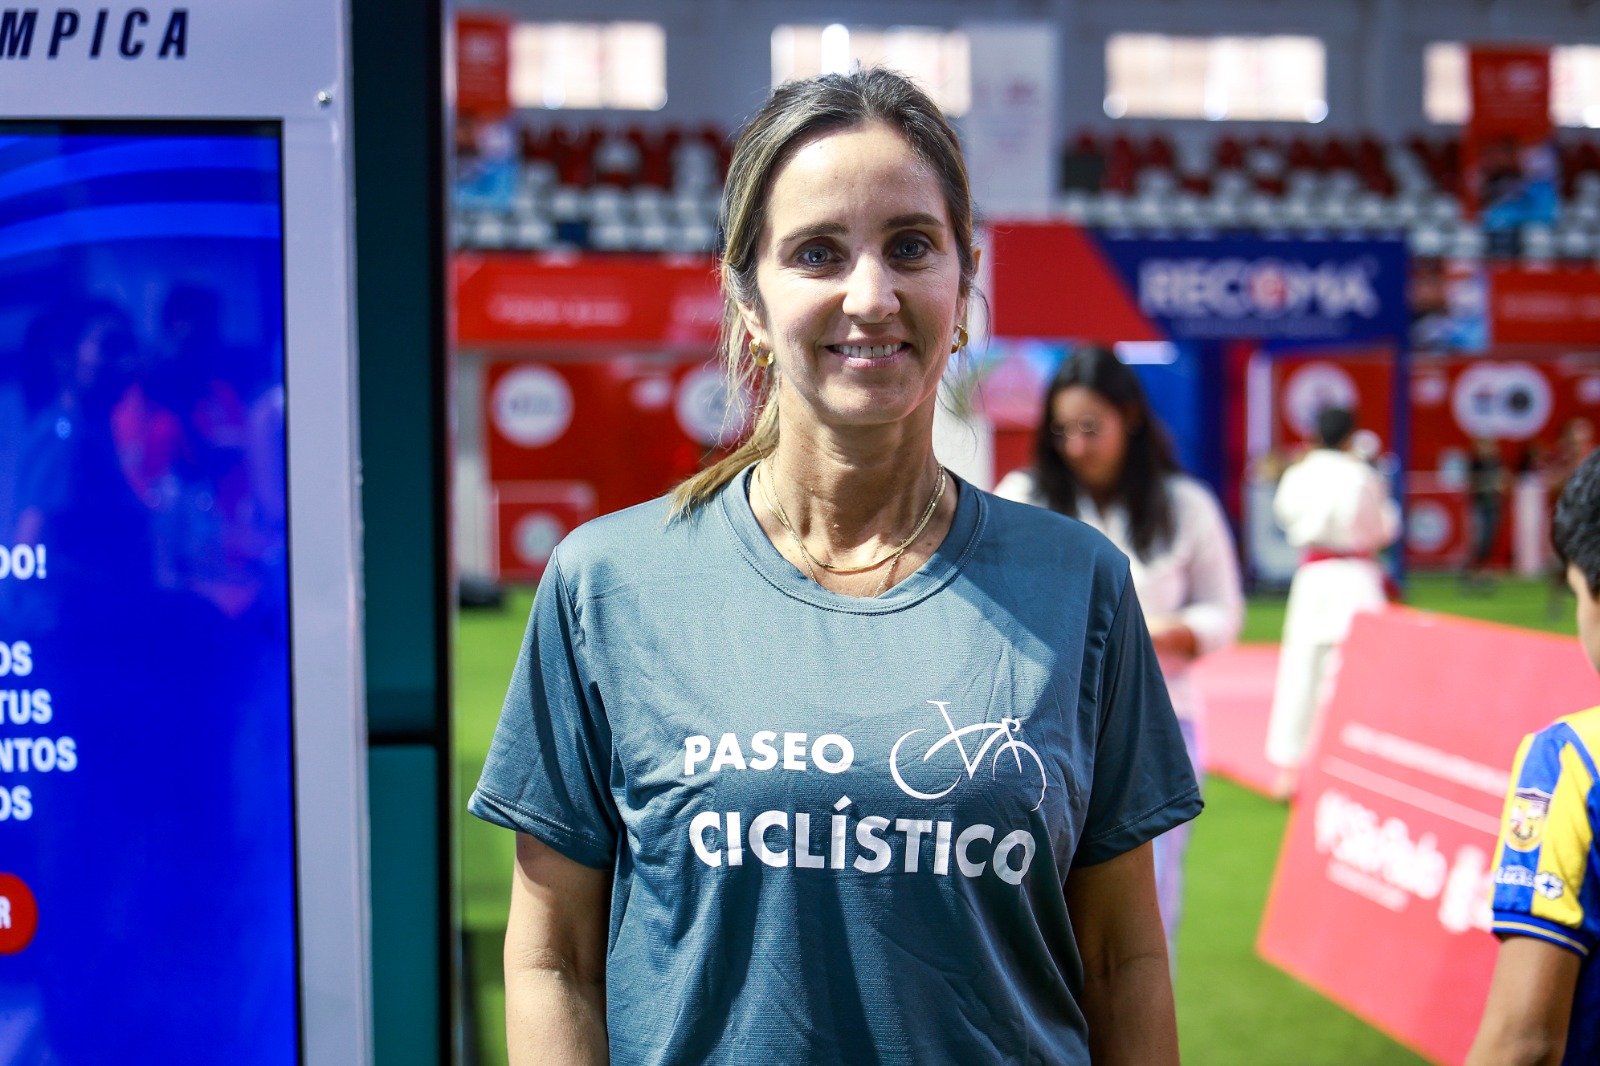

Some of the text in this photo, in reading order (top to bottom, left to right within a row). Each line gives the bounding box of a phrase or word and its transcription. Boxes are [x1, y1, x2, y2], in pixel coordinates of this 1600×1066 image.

[0, 8, 189, 60] MPICA
[0, 736, 78, 773] NTOS
[684, 731, 855, 775] PASEO
[689, 795, 1036, 885] CICLÍSTICO
